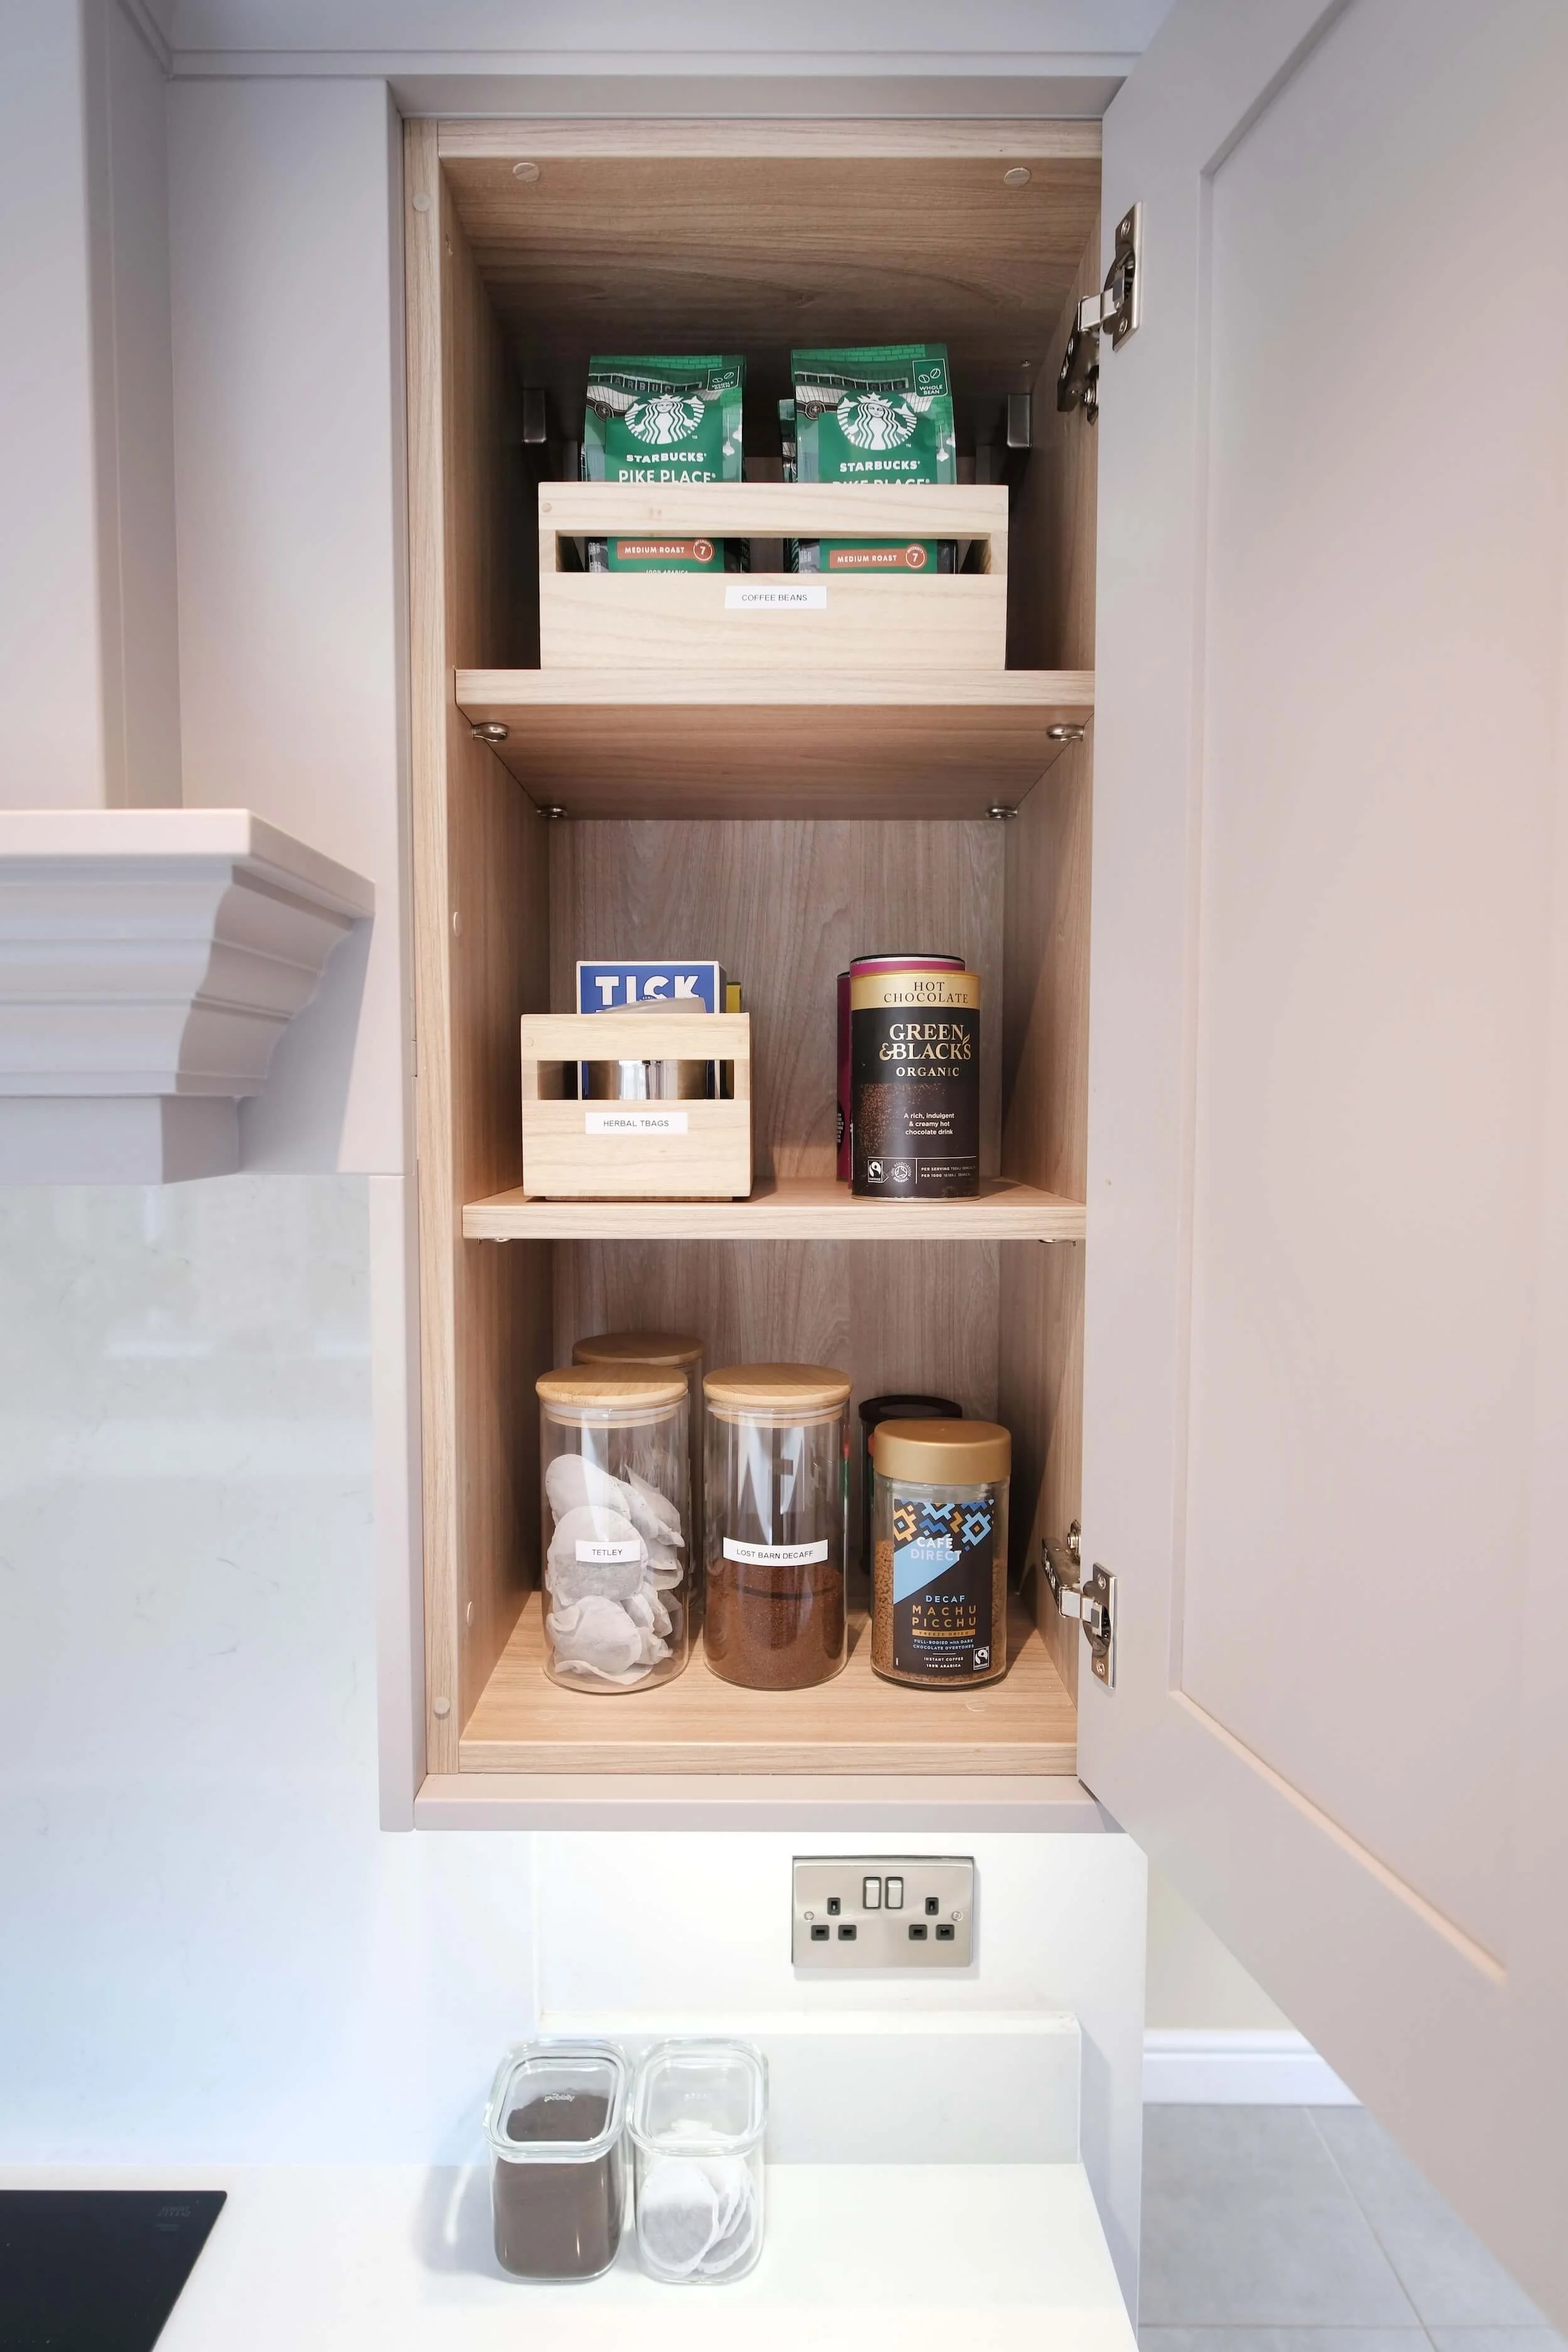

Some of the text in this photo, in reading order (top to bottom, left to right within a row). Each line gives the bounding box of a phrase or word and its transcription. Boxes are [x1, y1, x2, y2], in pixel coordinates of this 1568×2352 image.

[618, 469, 655, 483] PIKE
[700, 546, 706, 555] 7
[912, 553, 918, 562] 7
[914, 981, 945, 992] HOT
[884, 993, 968, 1004] CHOCOLATE
[889, 1024, 964, 1041] GREEN
[896, 1067, 960, 1077] ORGANIC
[591, 1548, 623, 1557] TETLEY
[736, 1549, 814, 1559] LOST BARN DECAFF
[911, 1550, 962, 1561] DIRECT
[925, 1595, 965, 1603] DECAF
[912, 1605, 977, 1616] MACHU
[912, 1617, 977, 1628] PICCHU
